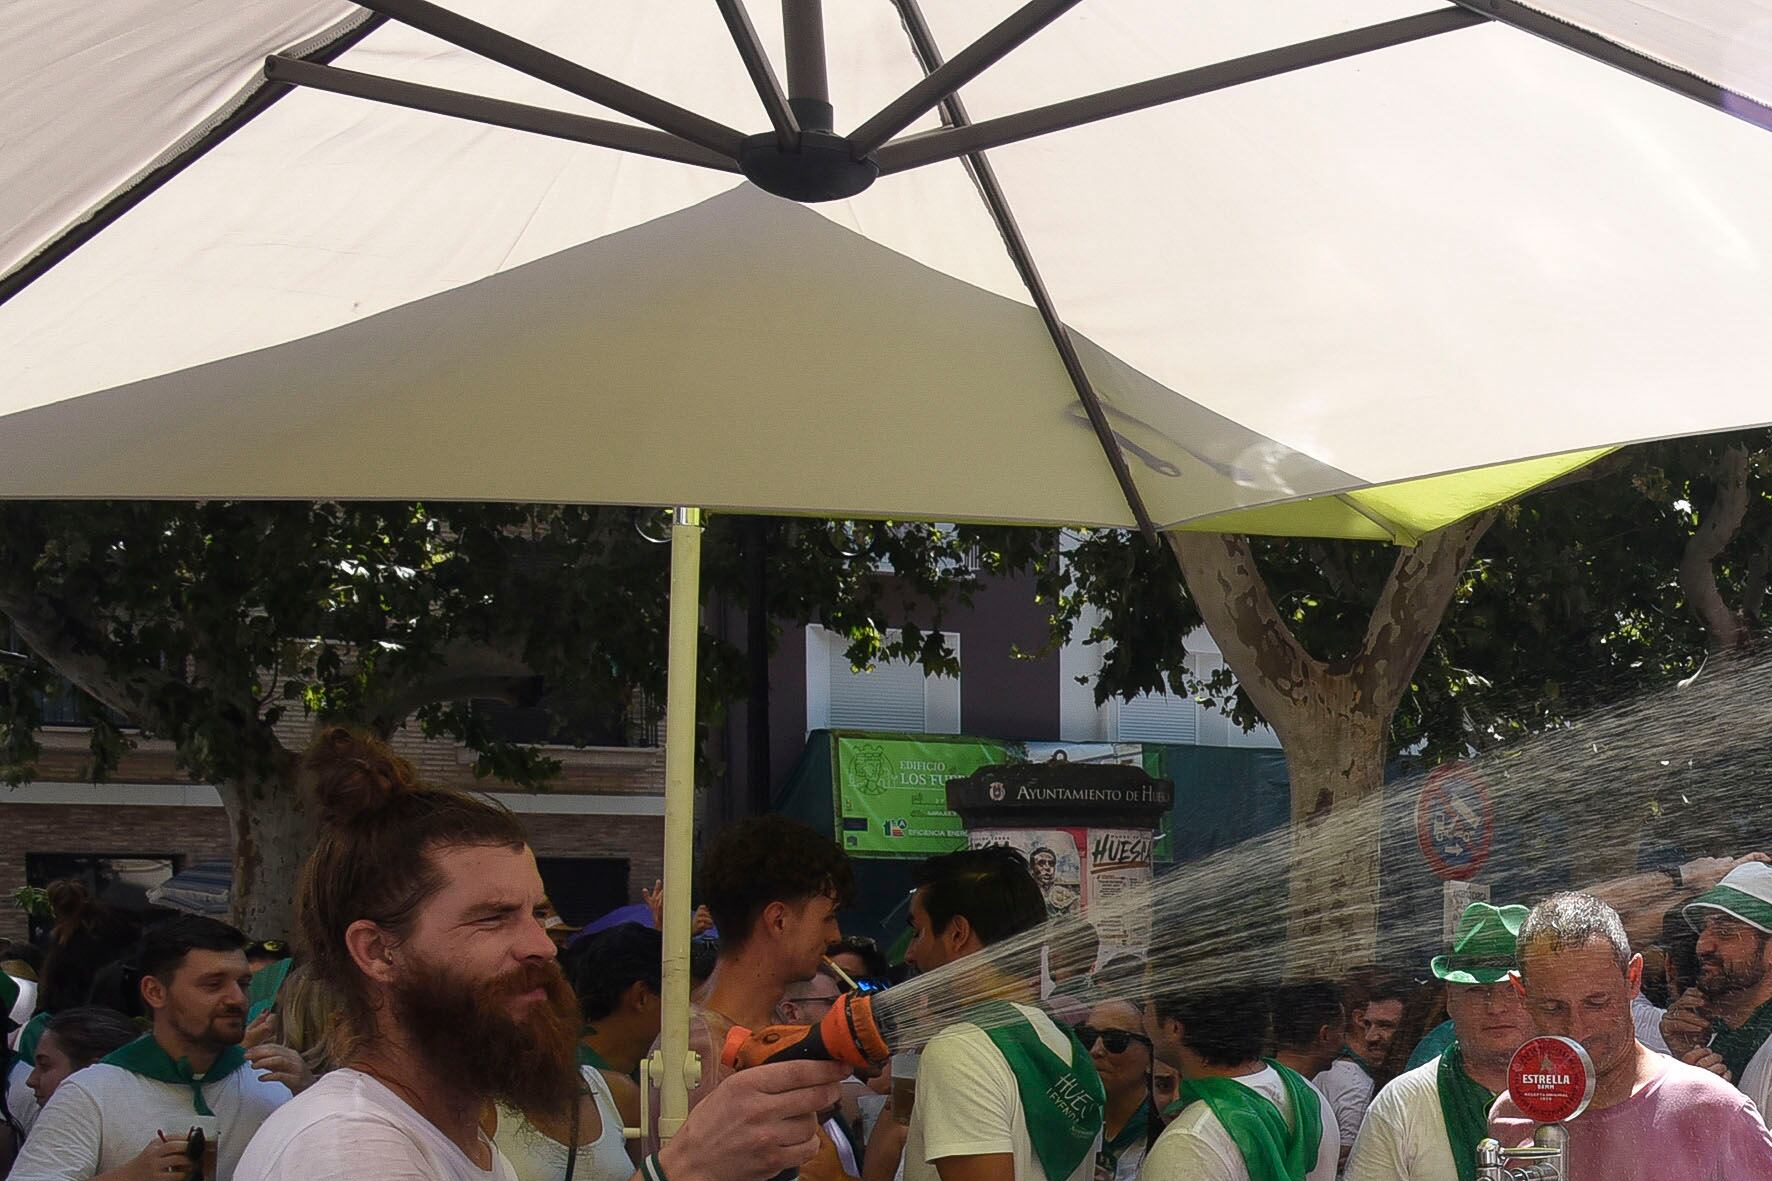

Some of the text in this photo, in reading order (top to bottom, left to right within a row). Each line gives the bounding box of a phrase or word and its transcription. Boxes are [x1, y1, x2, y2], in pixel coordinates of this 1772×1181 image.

[900, 760, 946, 772] EDIFICIO
[901, 773, 927, 786] LOS
[1522, 1074, 1570, 1085] ESTRELLA
